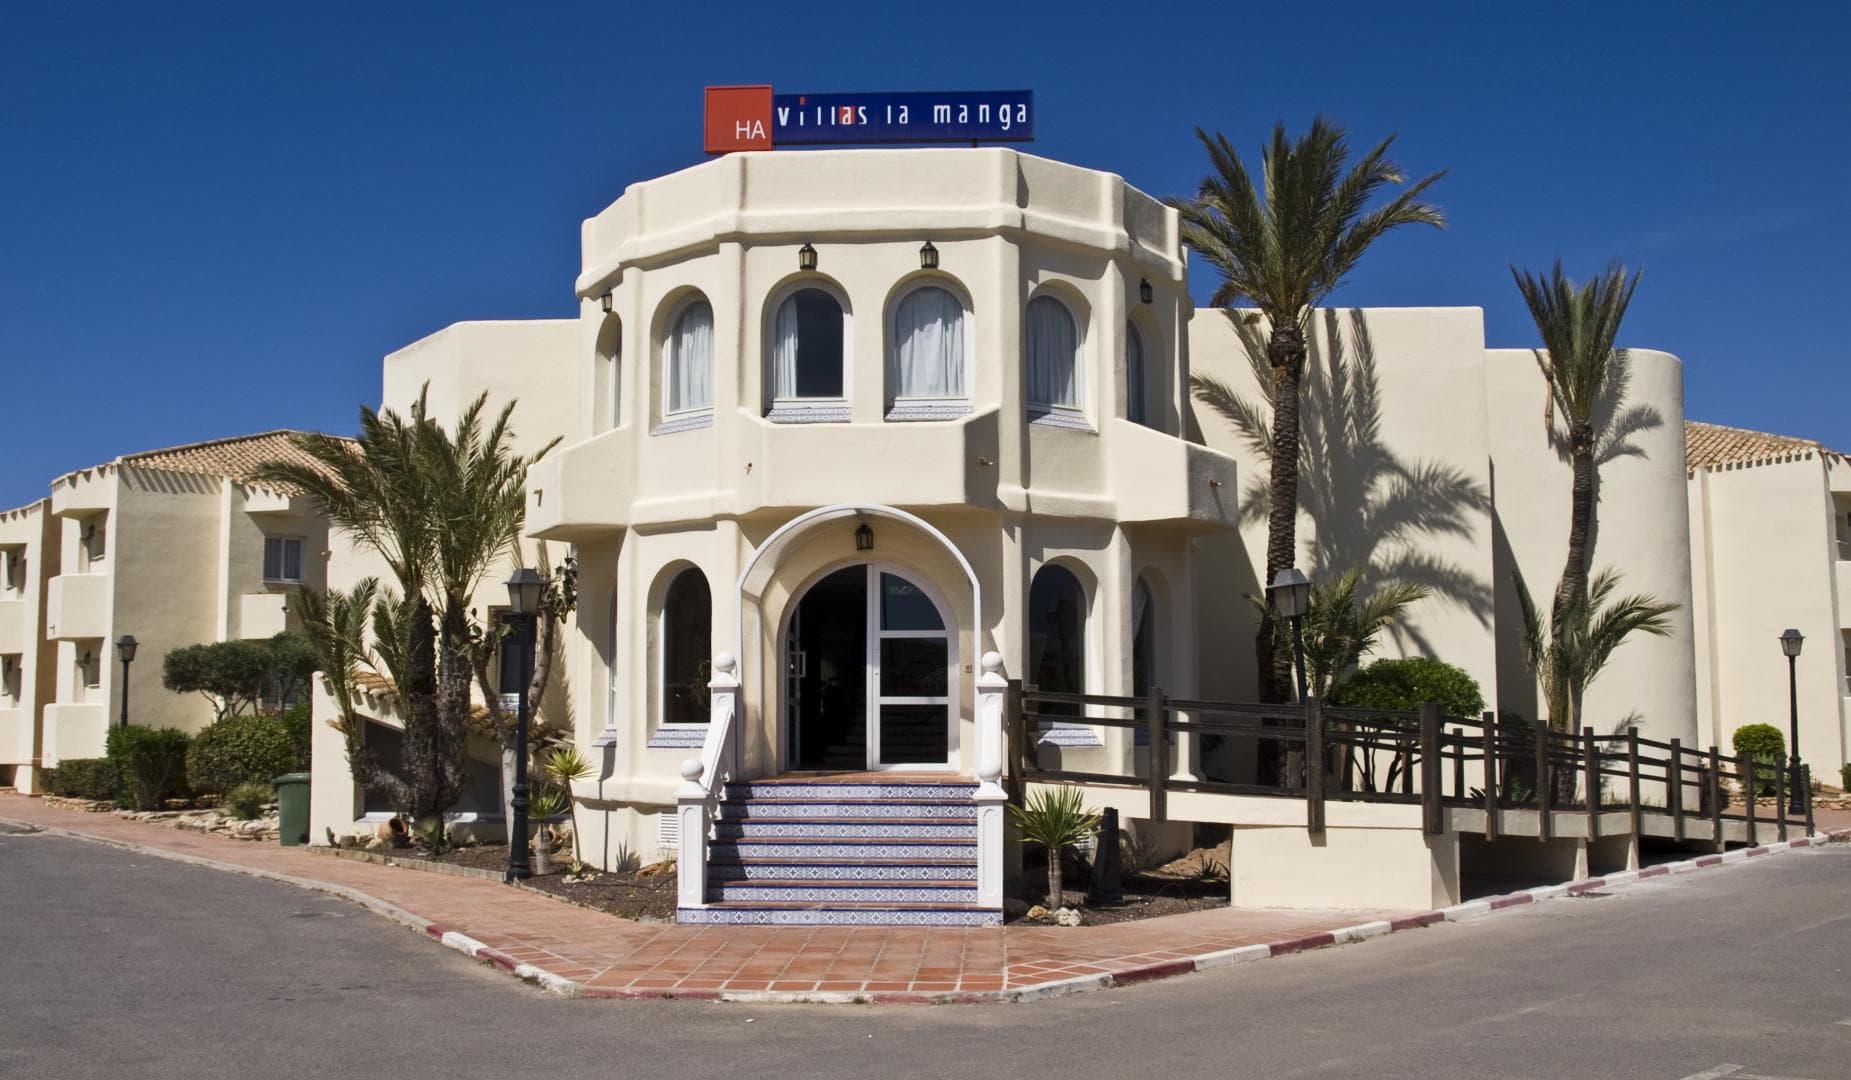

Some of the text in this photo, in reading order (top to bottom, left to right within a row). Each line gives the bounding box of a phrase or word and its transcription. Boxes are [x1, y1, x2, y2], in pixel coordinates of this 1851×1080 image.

[777, 96, 1027, 130] villas la manga
[736, 119, 766, 139] HA
